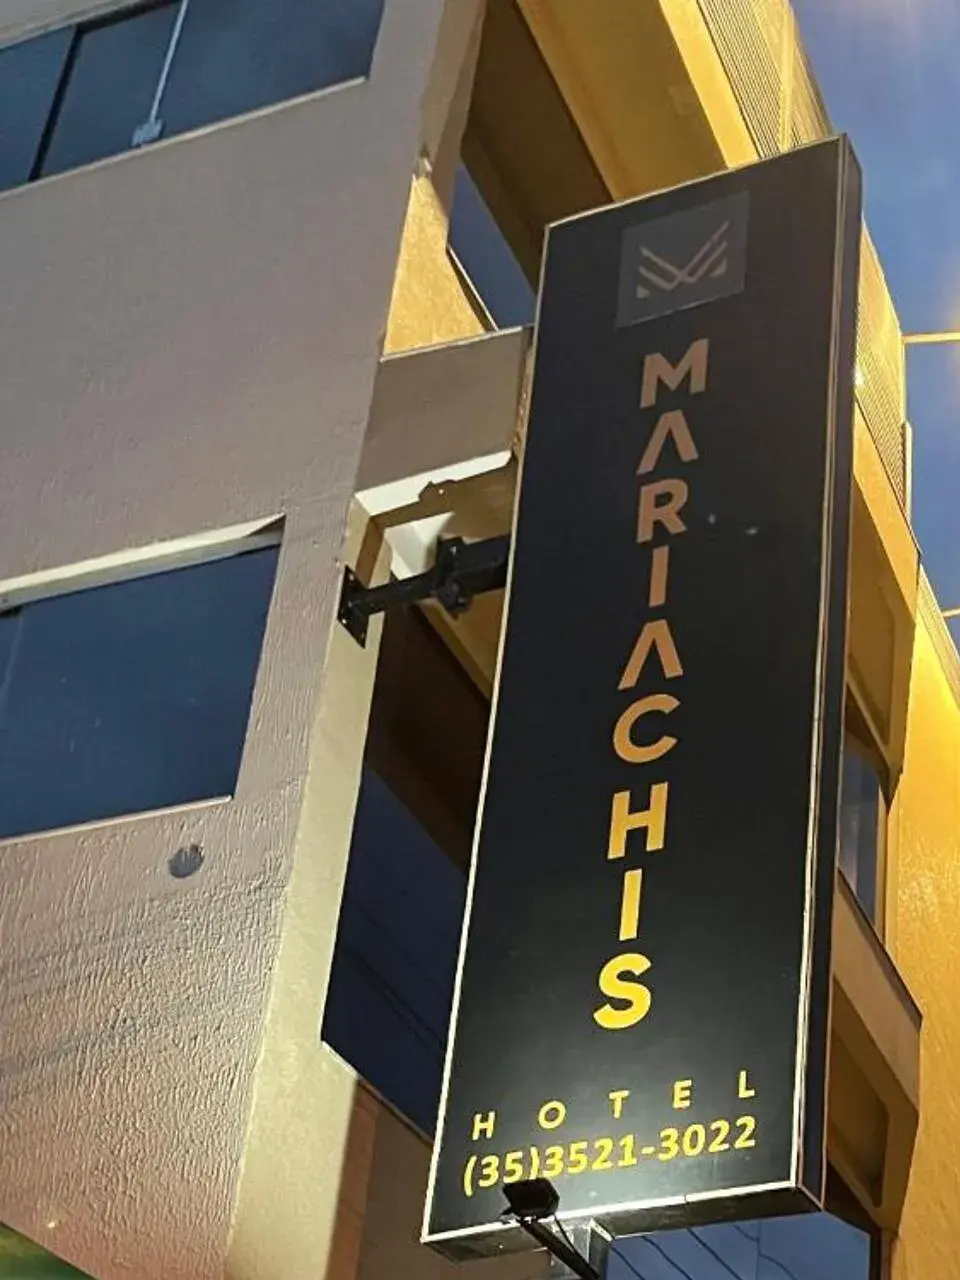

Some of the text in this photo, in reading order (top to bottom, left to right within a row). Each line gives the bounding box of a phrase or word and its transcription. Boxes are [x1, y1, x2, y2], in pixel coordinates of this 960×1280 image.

[593, 338, 709, 1030] MARIACHIS
[471, 1069, 756, 1141] HOTEL
[462, 1115, 757, 1199] (35)3521-3022
